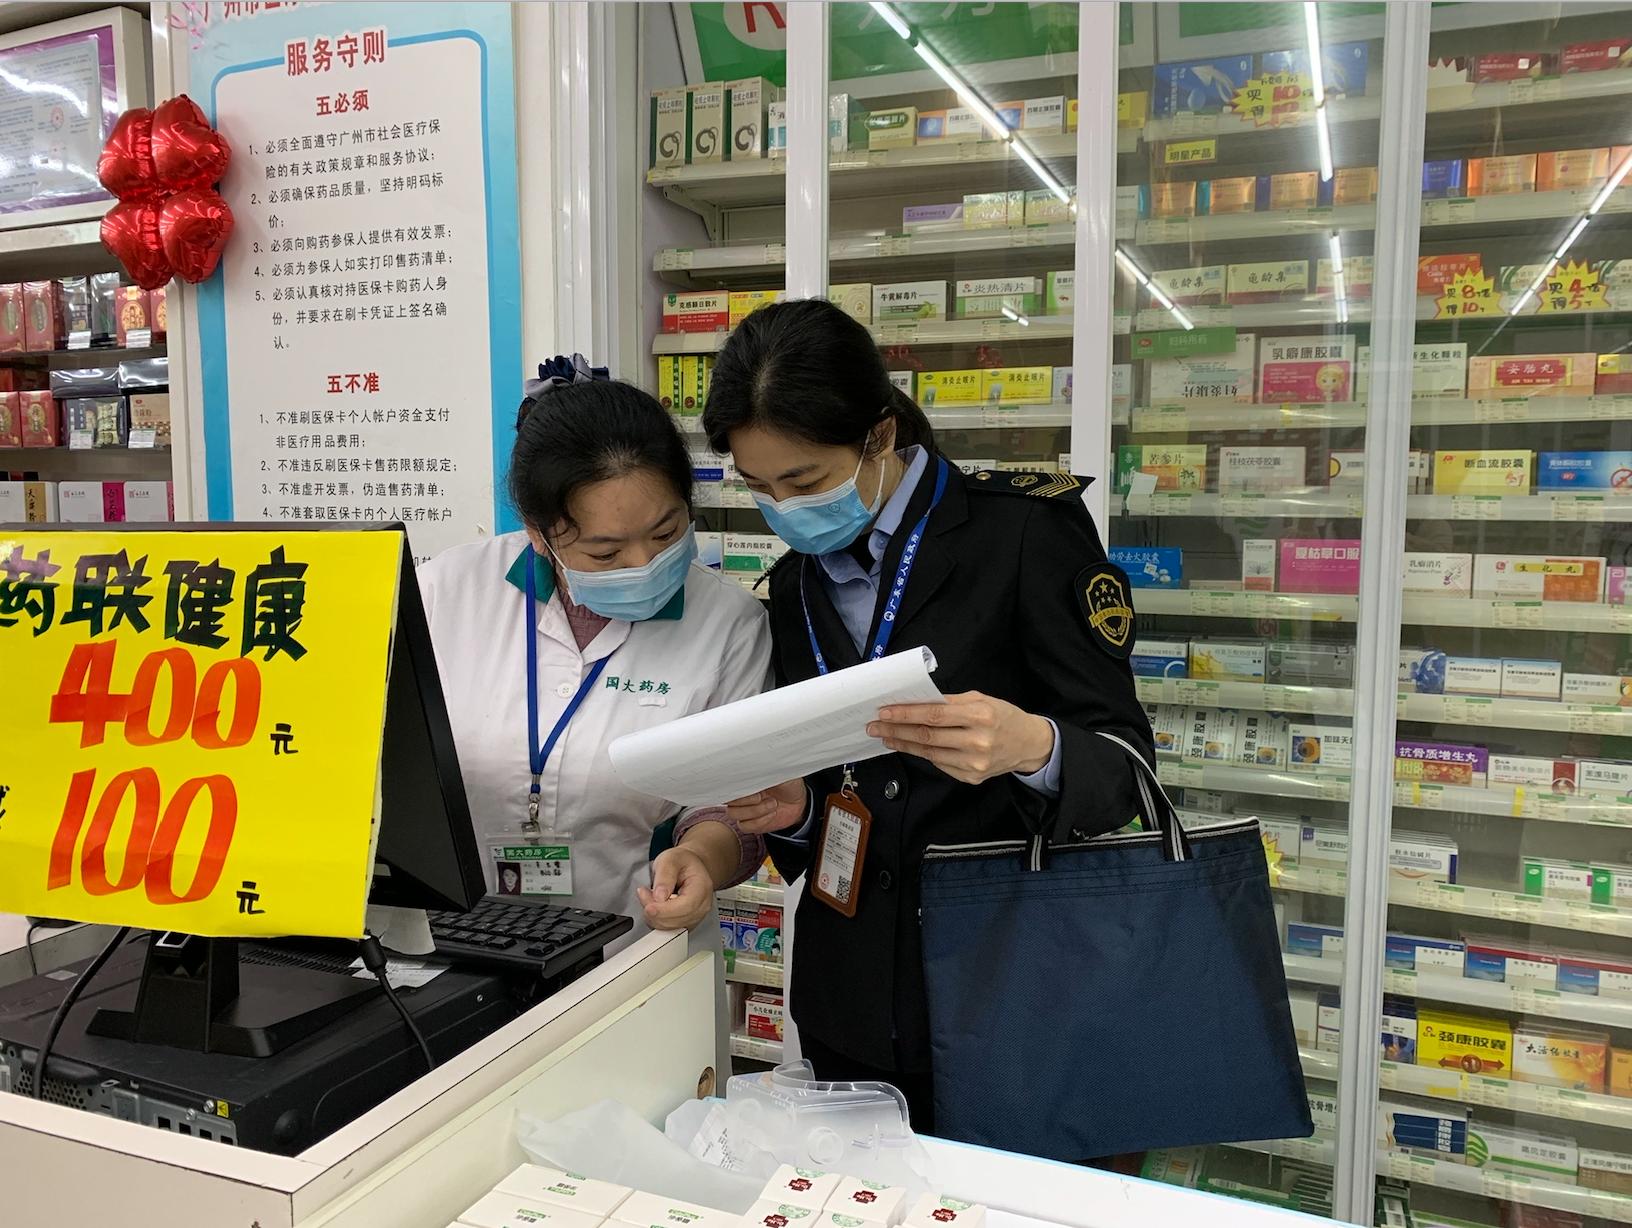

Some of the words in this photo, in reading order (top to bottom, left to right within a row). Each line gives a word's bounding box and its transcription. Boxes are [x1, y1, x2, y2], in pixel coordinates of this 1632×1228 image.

[287, 29, 385, 76] 服务守则
[316, 89, 369, 116] 五必须
[1507, 363, 1555, 375] 安胎丸
[327, 371, 380, 394] 五不准
[1464, 458, 1525, 469] 断血流胶囊
[890, 533, 920, 609] 广东省人民政府
[605, 675, 671, 696] 国大药房
[1399, 746, 1478, 763] 抗骨质增生丸
